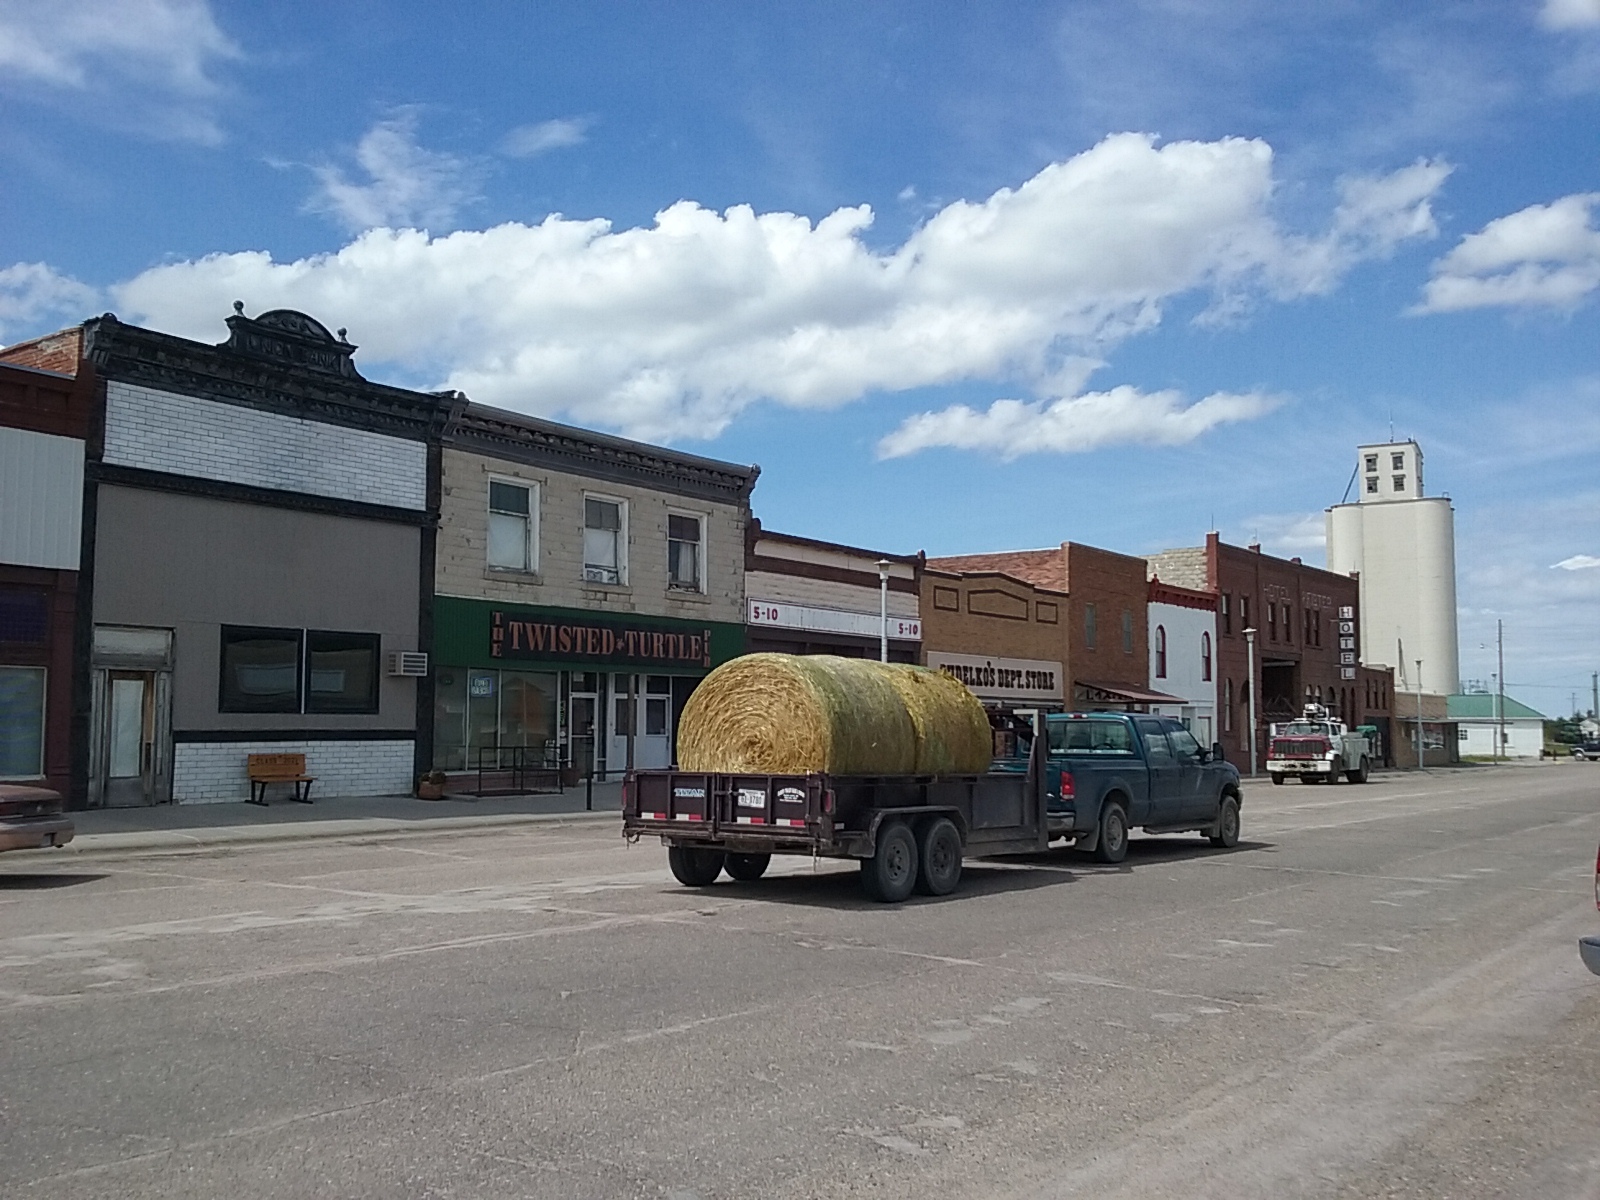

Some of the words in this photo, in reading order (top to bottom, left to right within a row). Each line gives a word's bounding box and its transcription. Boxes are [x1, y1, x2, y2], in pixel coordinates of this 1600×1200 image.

[1263, 583, 1291, 601] HOTEL
[753, 606, 779, 621] 5-10
[492, 611, 504, 657] THE
[509, 620, 616, 656] TWISTED
[624, 630, 702, 660] TURTLE
[898, 622, 919, 636] 5-10
[1341, 607, 1353, 679] HOTEL
[997, 668, 1025, 689] DEPT.
[1025, 669, 1055, 690] STORE
